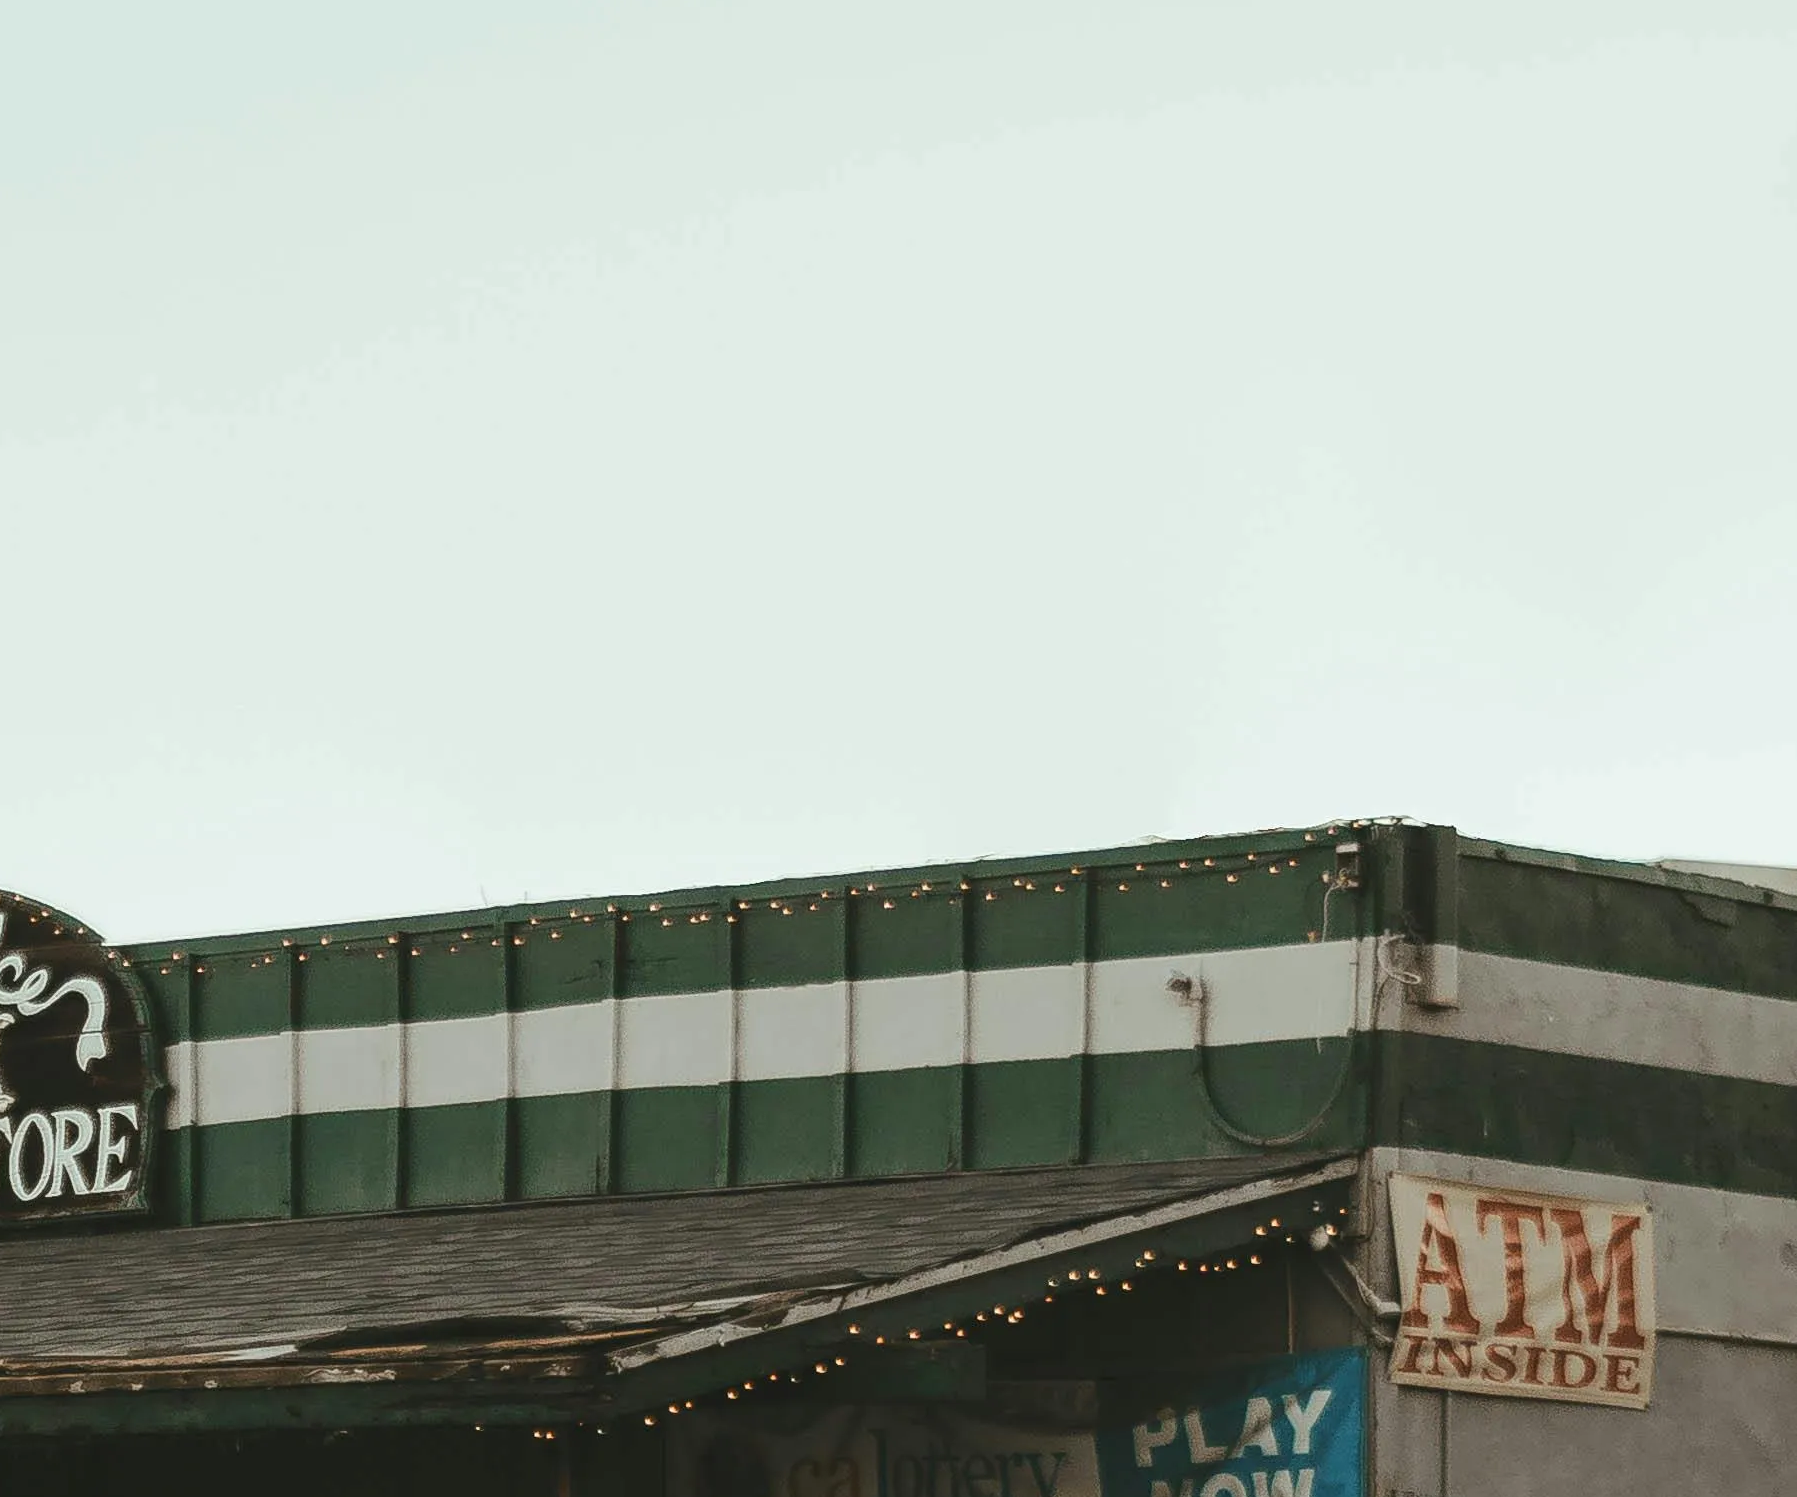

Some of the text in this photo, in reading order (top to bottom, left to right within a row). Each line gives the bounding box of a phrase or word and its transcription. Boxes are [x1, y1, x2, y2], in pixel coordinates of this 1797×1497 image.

[1400, 1192, 1646, 1350] ATM
[1397, 1334, 1642, 1396] INSIDE
[1132, 1388, 1333, 1468] PLAY
